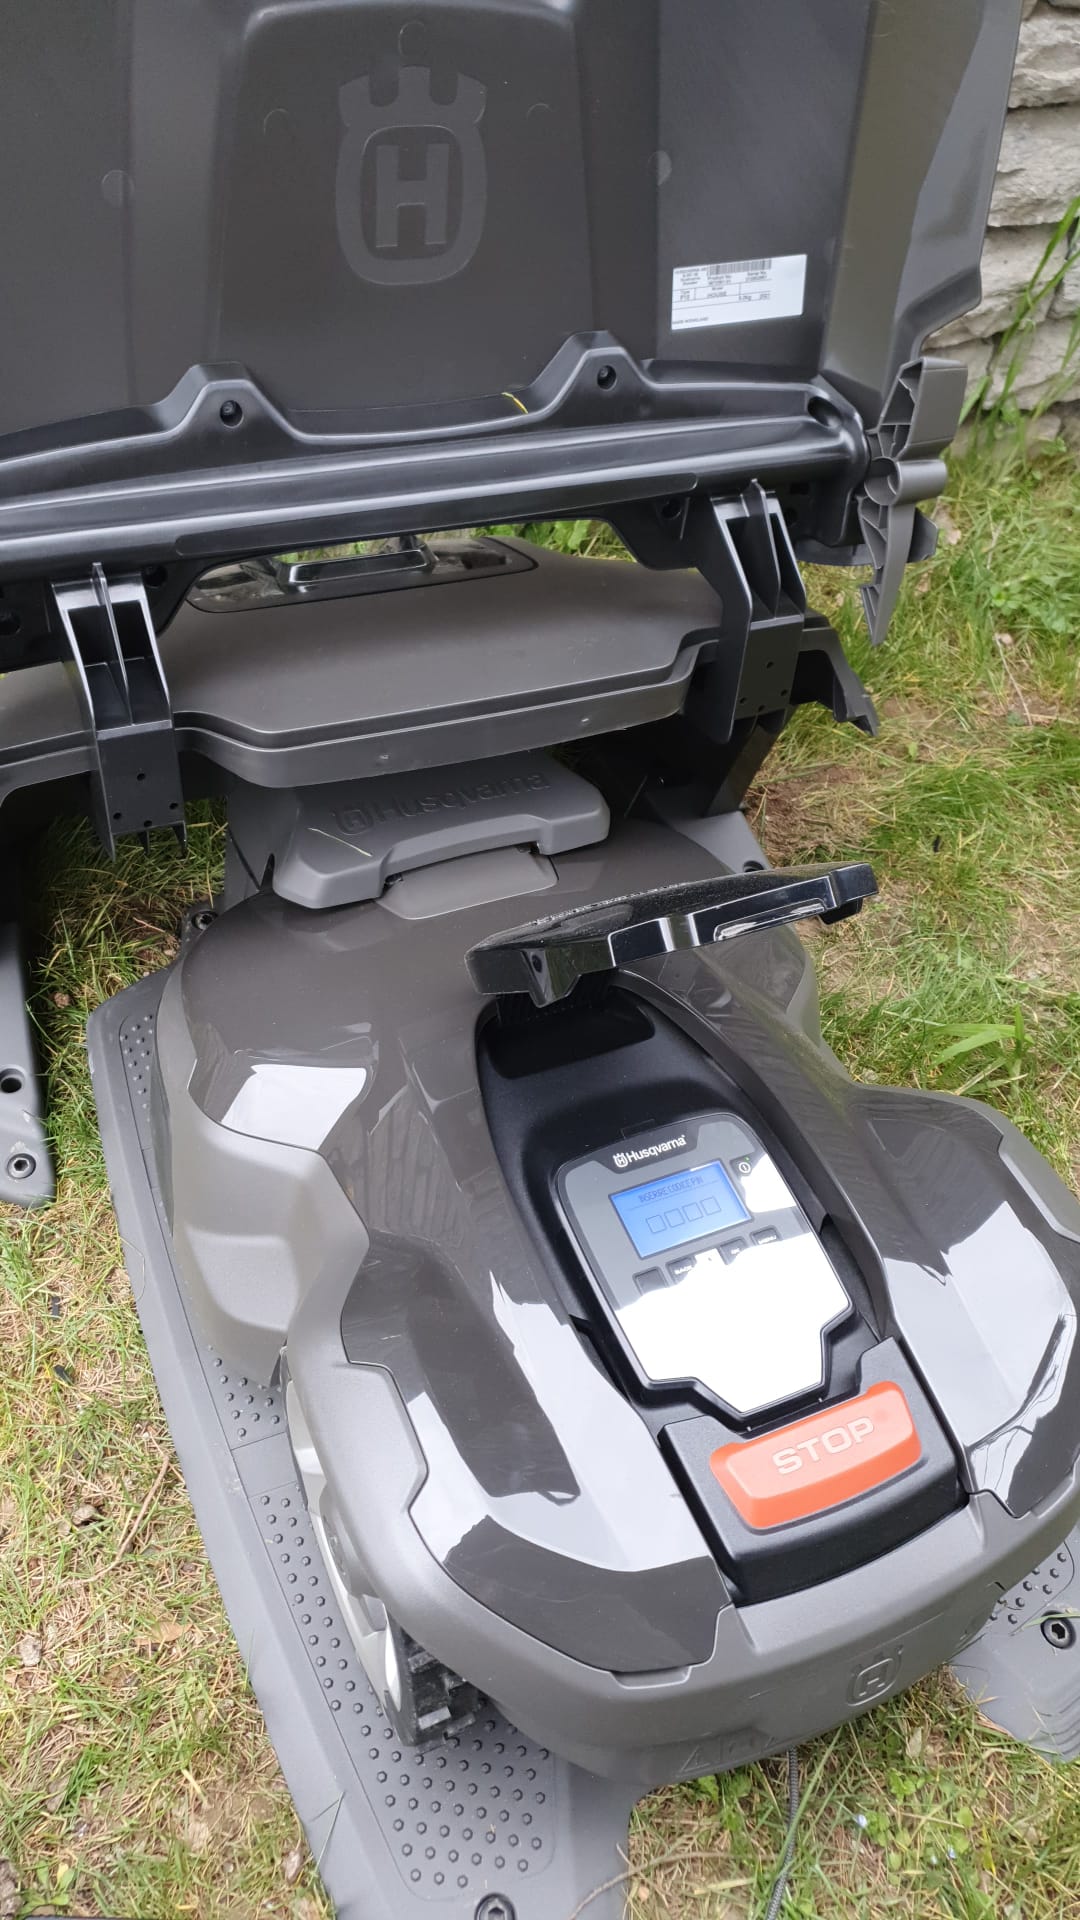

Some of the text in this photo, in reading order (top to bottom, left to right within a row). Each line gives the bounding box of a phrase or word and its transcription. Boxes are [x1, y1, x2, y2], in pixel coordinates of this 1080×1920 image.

[374, 772, 550, 822] Husqvarna
[626, 1136, 686, 1163] Husqvarna
[772, 1416, 874, 1475] STOP
